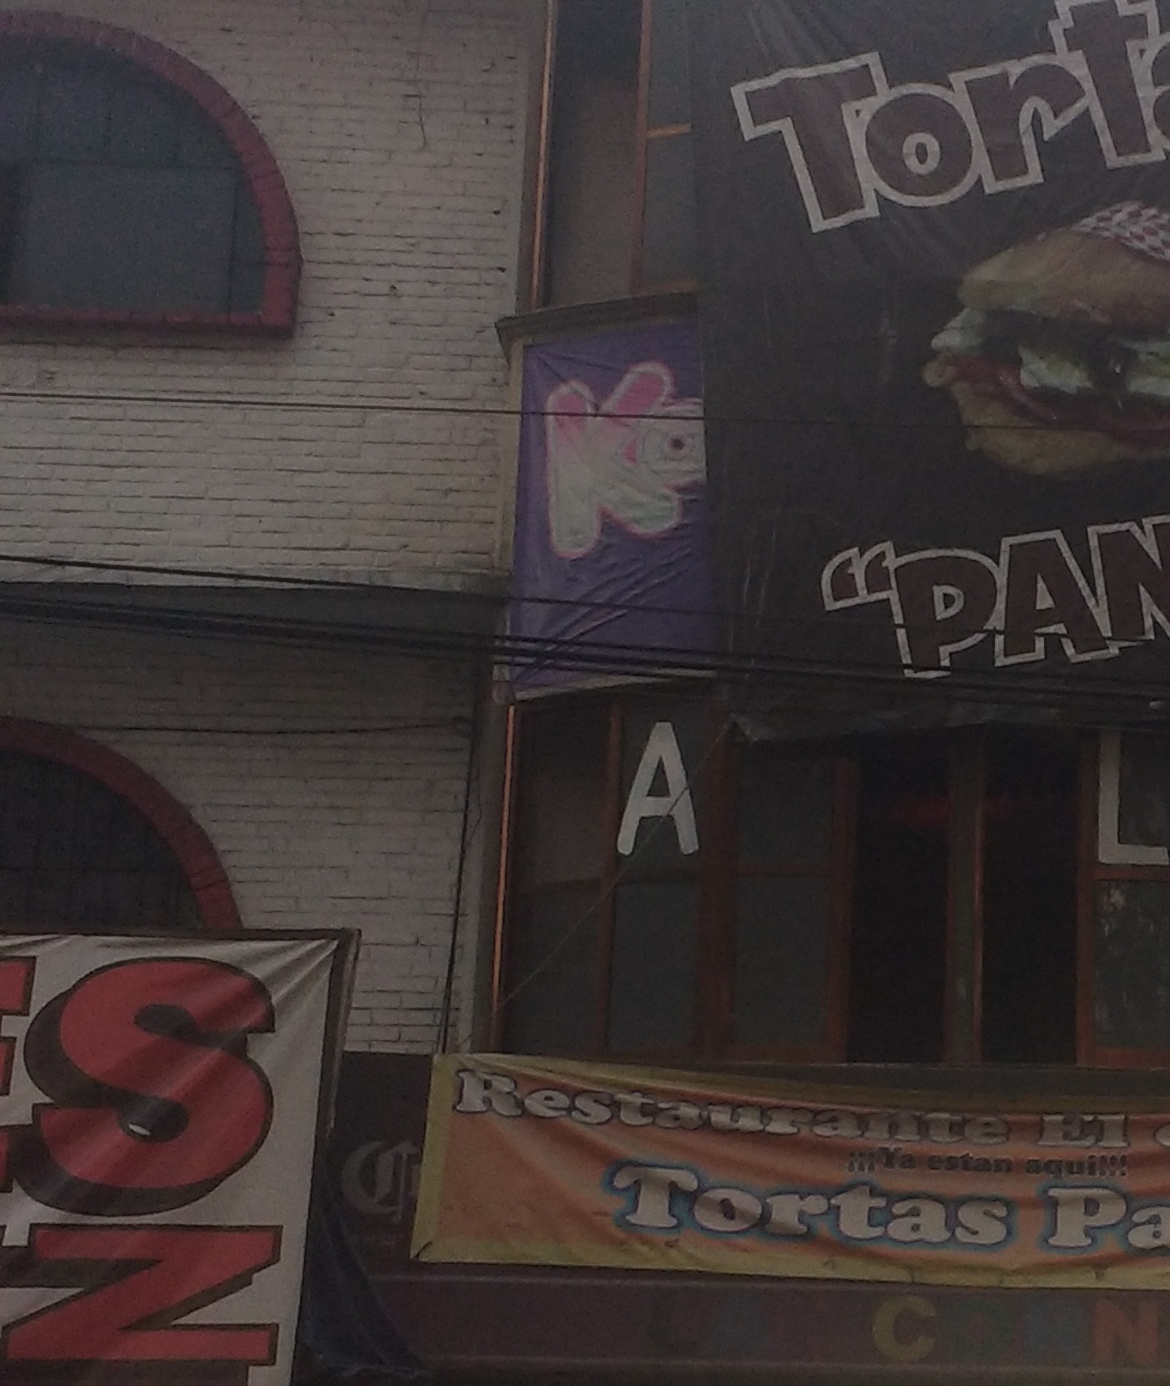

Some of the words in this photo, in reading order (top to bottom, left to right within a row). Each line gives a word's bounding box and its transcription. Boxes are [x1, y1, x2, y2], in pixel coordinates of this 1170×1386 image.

[454, 1069, 1008, 1145] Restaurante
[1037, 1112, 1129, 1147] El
[612, 1162, 1009, 1245] Tortas
